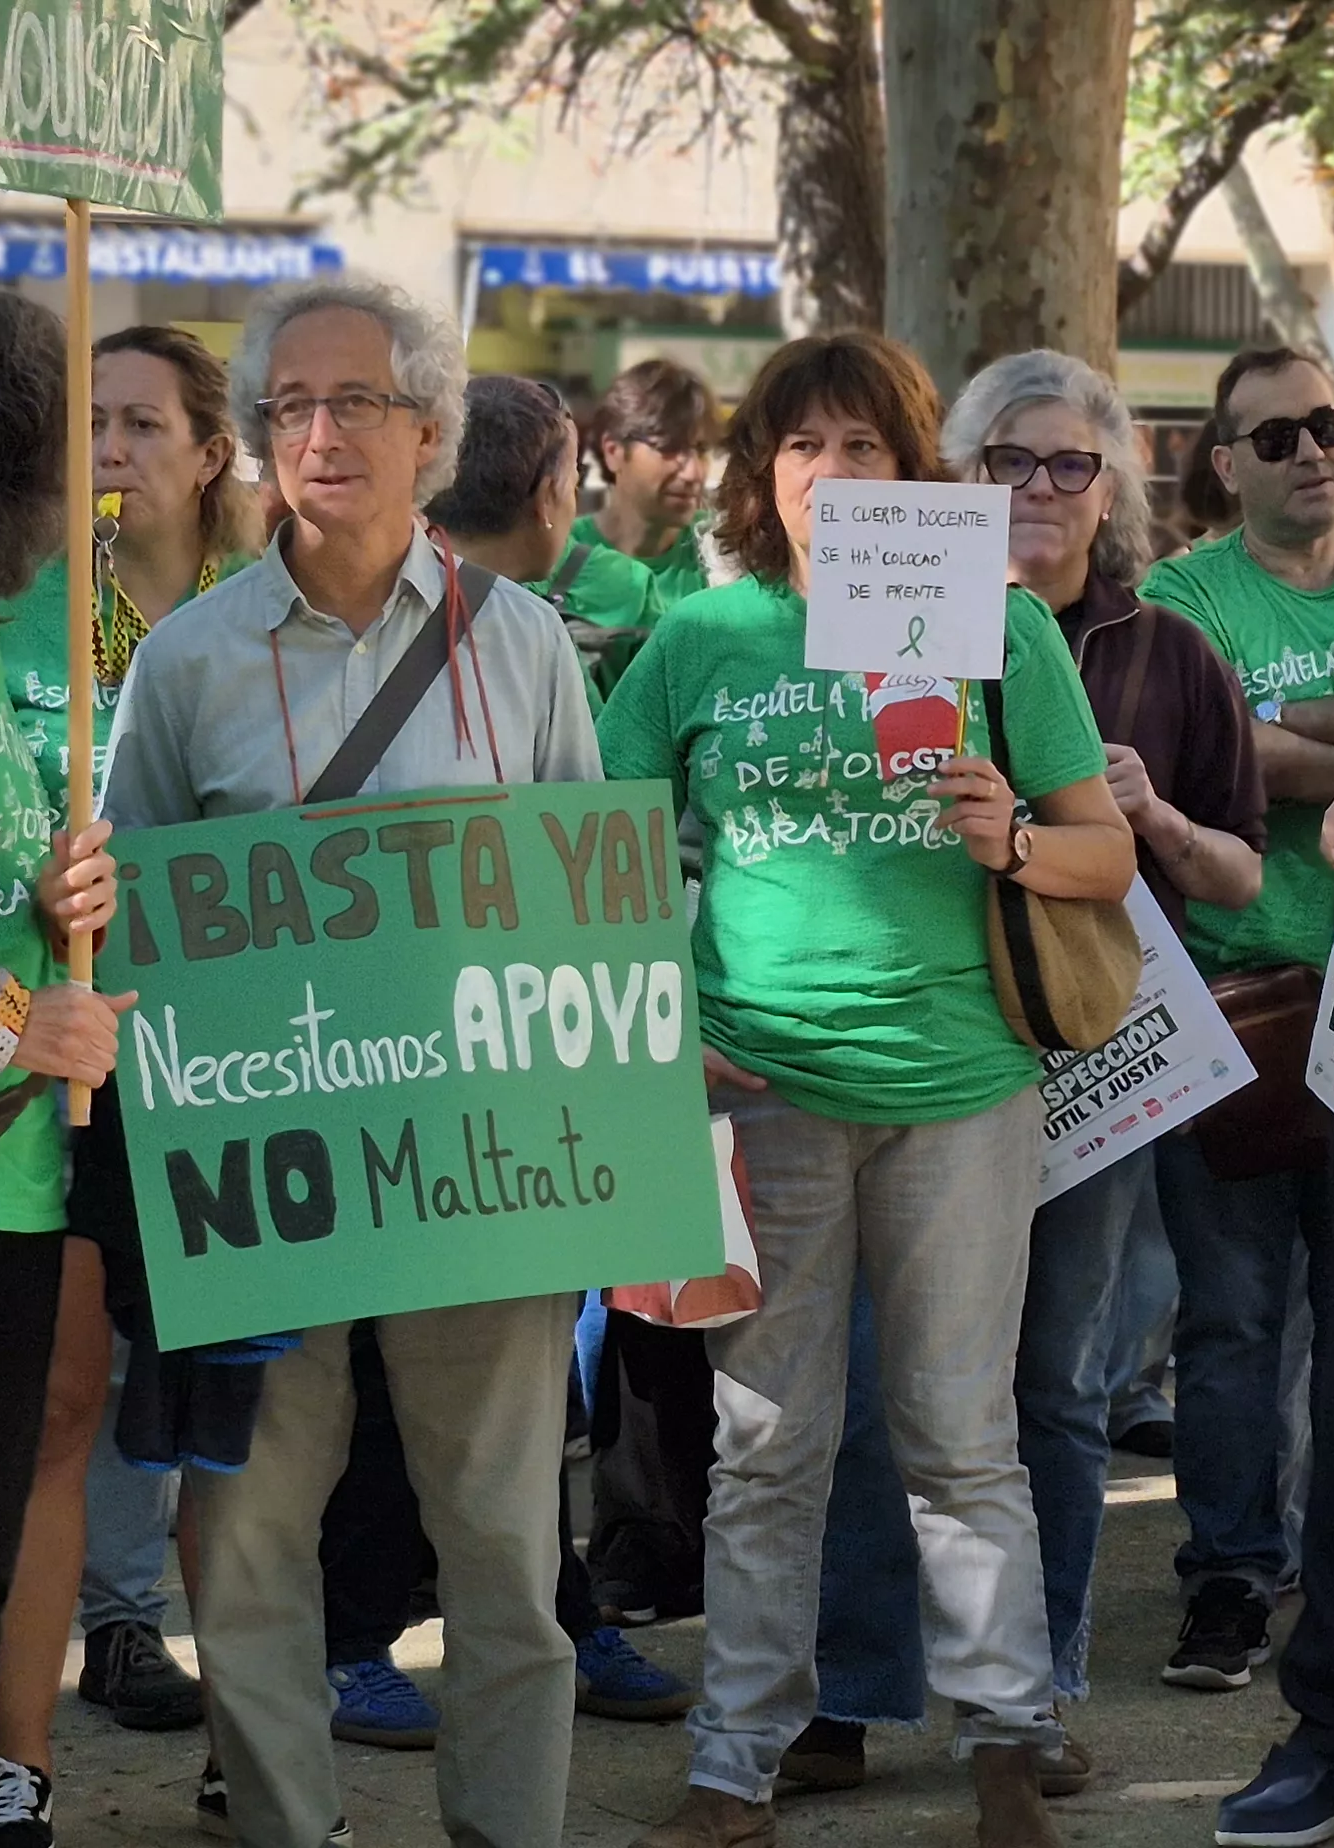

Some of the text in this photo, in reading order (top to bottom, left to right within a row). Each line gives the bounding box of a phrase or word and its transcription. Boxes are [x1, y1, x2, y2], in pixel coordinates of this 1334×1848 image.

[568, 252, 611, 284] EL
[820, 503, 989, 528] EL CUERPO DOCENTE
[818, 547, 840, 565] SE
[851, 549, 871, 565] HA
[847, 583, 945, 600] DE FRENTE
[713, 681, 845, 723] ESCUELA
[735, 755, 790, 793] DE
[889, 747, 955, 775] CGT
[731, 812, 832, 856] PARA
[119, 807, 673, 967] ¡BASTA YA!
[133, 960, 683, 1110] Necesitamos APOYO
[1087, 1089, 1104, 1110] Y
[1107, 1051, 1170, 1101] JUSTA
[164, 1105, 616, 1258] NO Maltrato
